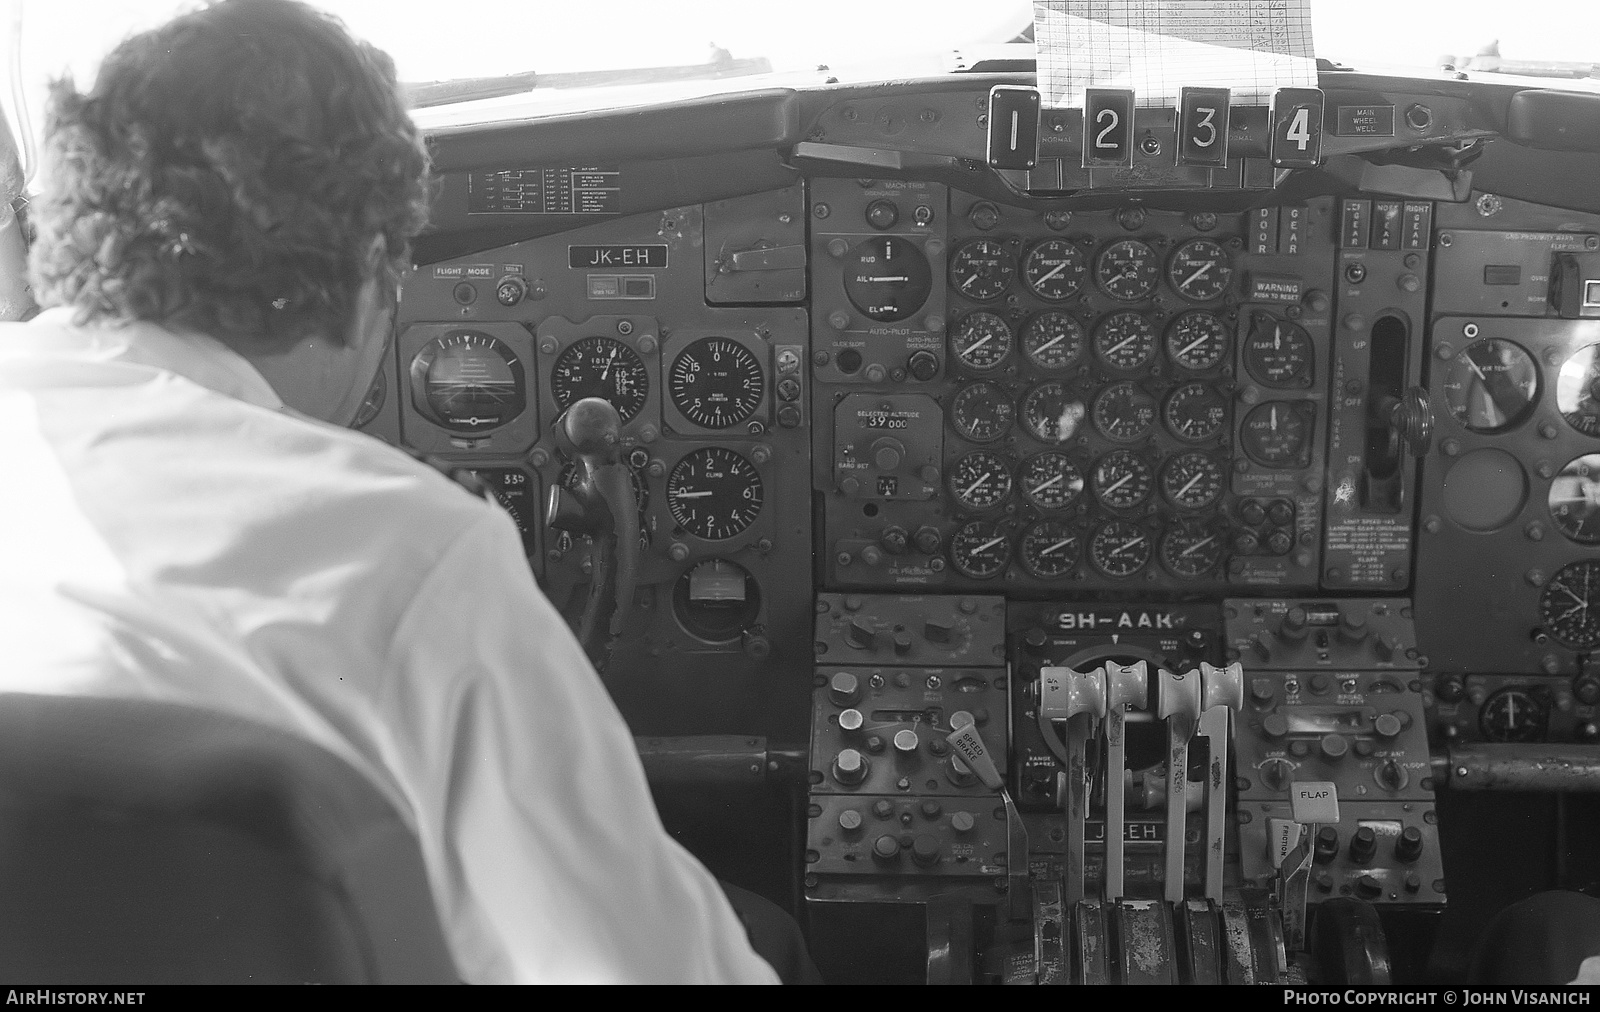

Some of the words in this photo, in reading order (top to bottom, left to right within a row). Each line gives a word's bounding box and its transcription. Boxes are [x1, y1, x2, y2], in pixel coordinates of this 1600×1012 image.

[1352, 117, 1378, 125] WHEEL
[1010, 110, 1018, 150] 1
[1095, 108, 1119, 149] 2
[1192, 107, 1217, 148] 3
[1286, 108, 1311, 151] 4
[1355, 124, 1376, 132] WELL
[1406, 205, 1429, 213] RIGHT
[1258, 208, 1269, 254] DOOR
[1289, 209, 1298, 254] GEAR
[590, 249, 649, 265] JK-EH
[468, 268, 490, 276] MODE
[856, 275, 868, 283] AIL
[1257, 282, 1298, 292] WARNING
[596, 345, 603, 353] 0
[576, 352, 583, 360] 9
[713, 352, 720, 362] 0
[632, 368, 637, 376] 2
[690, 362, 701, 372] 15
[564, 368, 571, 377] 8
[685, 373, 695, 383] 10
[743, 379, 751, 389] 2
[566, 390, 571, 399] 7
[632, 388, 638, 397] 3
[694, 398, 702, 408] 5
[735, 398, 742, 408] 3
[715, 406, 721, 415] 4
[869, 416, 886, 427] 39
[888, 420, 908, 429] 000
[706, 458, 714, 470] 2
[730, 464, 740, 475] 4
[742, 487, 752, 499] 6
[730, 509, 740, 521] 4
[706, 516, 715, 527] 2
[1058, 612, 1173, 629] 9H-AAK
[962, 733, 985, 757] SPEED
[955, 738, 978, 763] BRAKE
[1300, 791, 1329, 799] FLAP
[1096, 824, 1157, 839] J-EH
[1280, 825, 1290, 856] FRICTION
